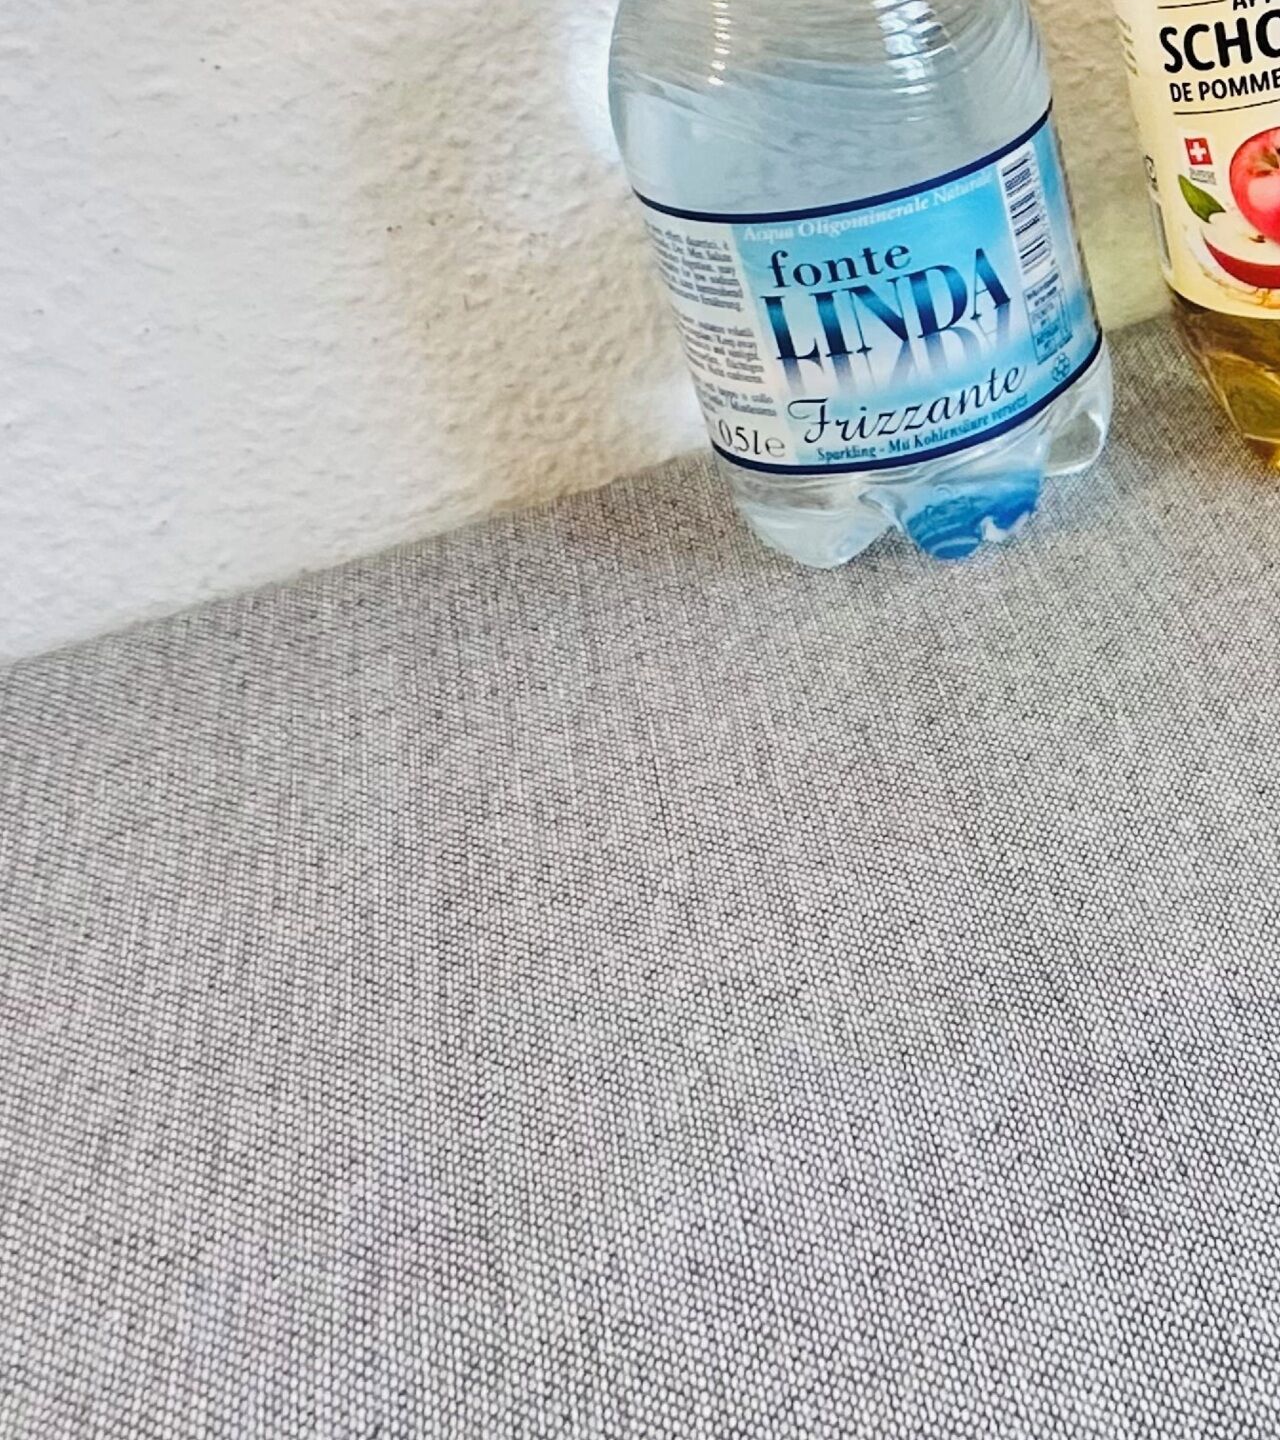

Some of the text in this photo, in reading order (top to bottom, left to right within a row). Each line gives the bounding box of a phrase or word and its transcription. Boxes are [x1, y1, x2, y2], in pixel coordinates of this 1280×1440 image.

[1169, 80, 1194, 104] DE
[743, 224, 795, 245] Acqua
[799, 194, 930, 239] Oligominerale
[767, 244, 913, 290] fonte
[760, 246, 1011, 361] LINDA
[786, 364, 1028, 444] Frizzante
[816, 444, 878, 465] Sparkling
[913, 416, 990, 449] Kohlensäure
